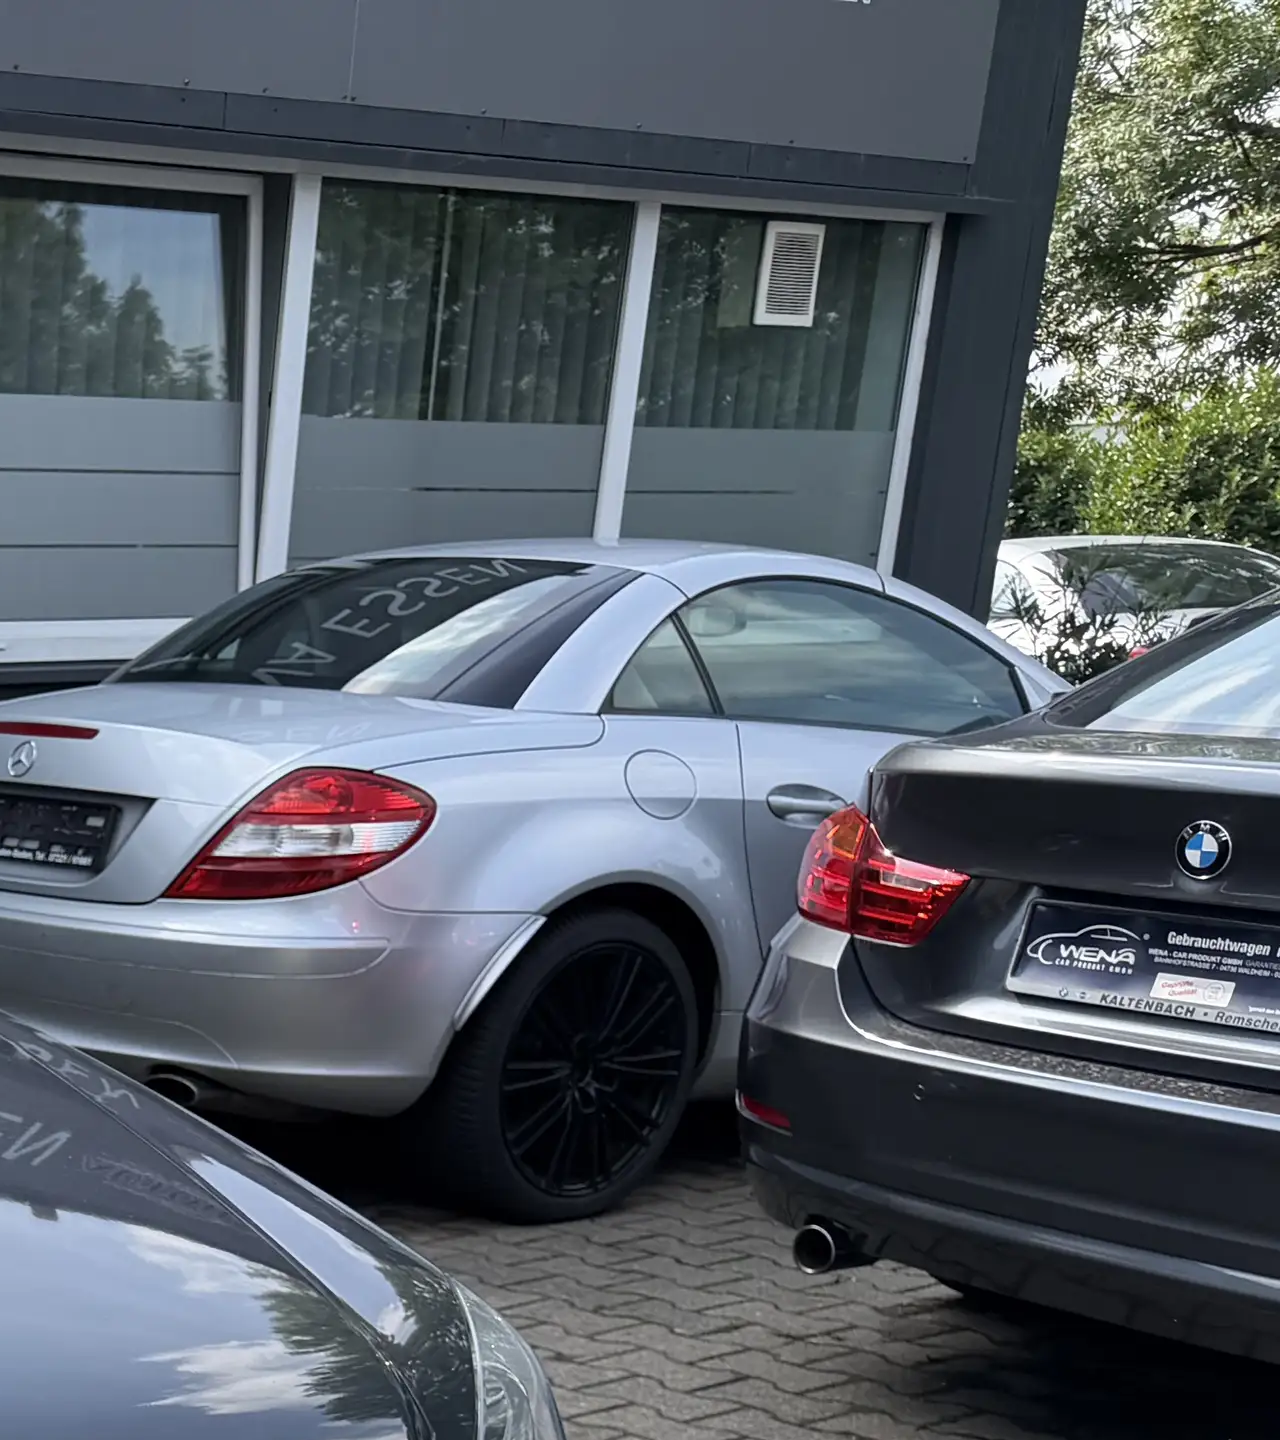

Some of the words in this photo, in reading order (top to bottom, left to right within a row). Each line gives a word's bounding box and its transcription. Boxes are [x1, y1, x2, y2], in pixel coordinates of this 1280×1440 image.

[1182, 823, 1228, 843] BMW
[1167, 931, 1271, 956] Gebrauchtwagen
[1059, 944, 1137, 966] WENA
[1172, 951, 1188, 960] CAR
[1100, 992, 1196, 1018] KALTENBACH
